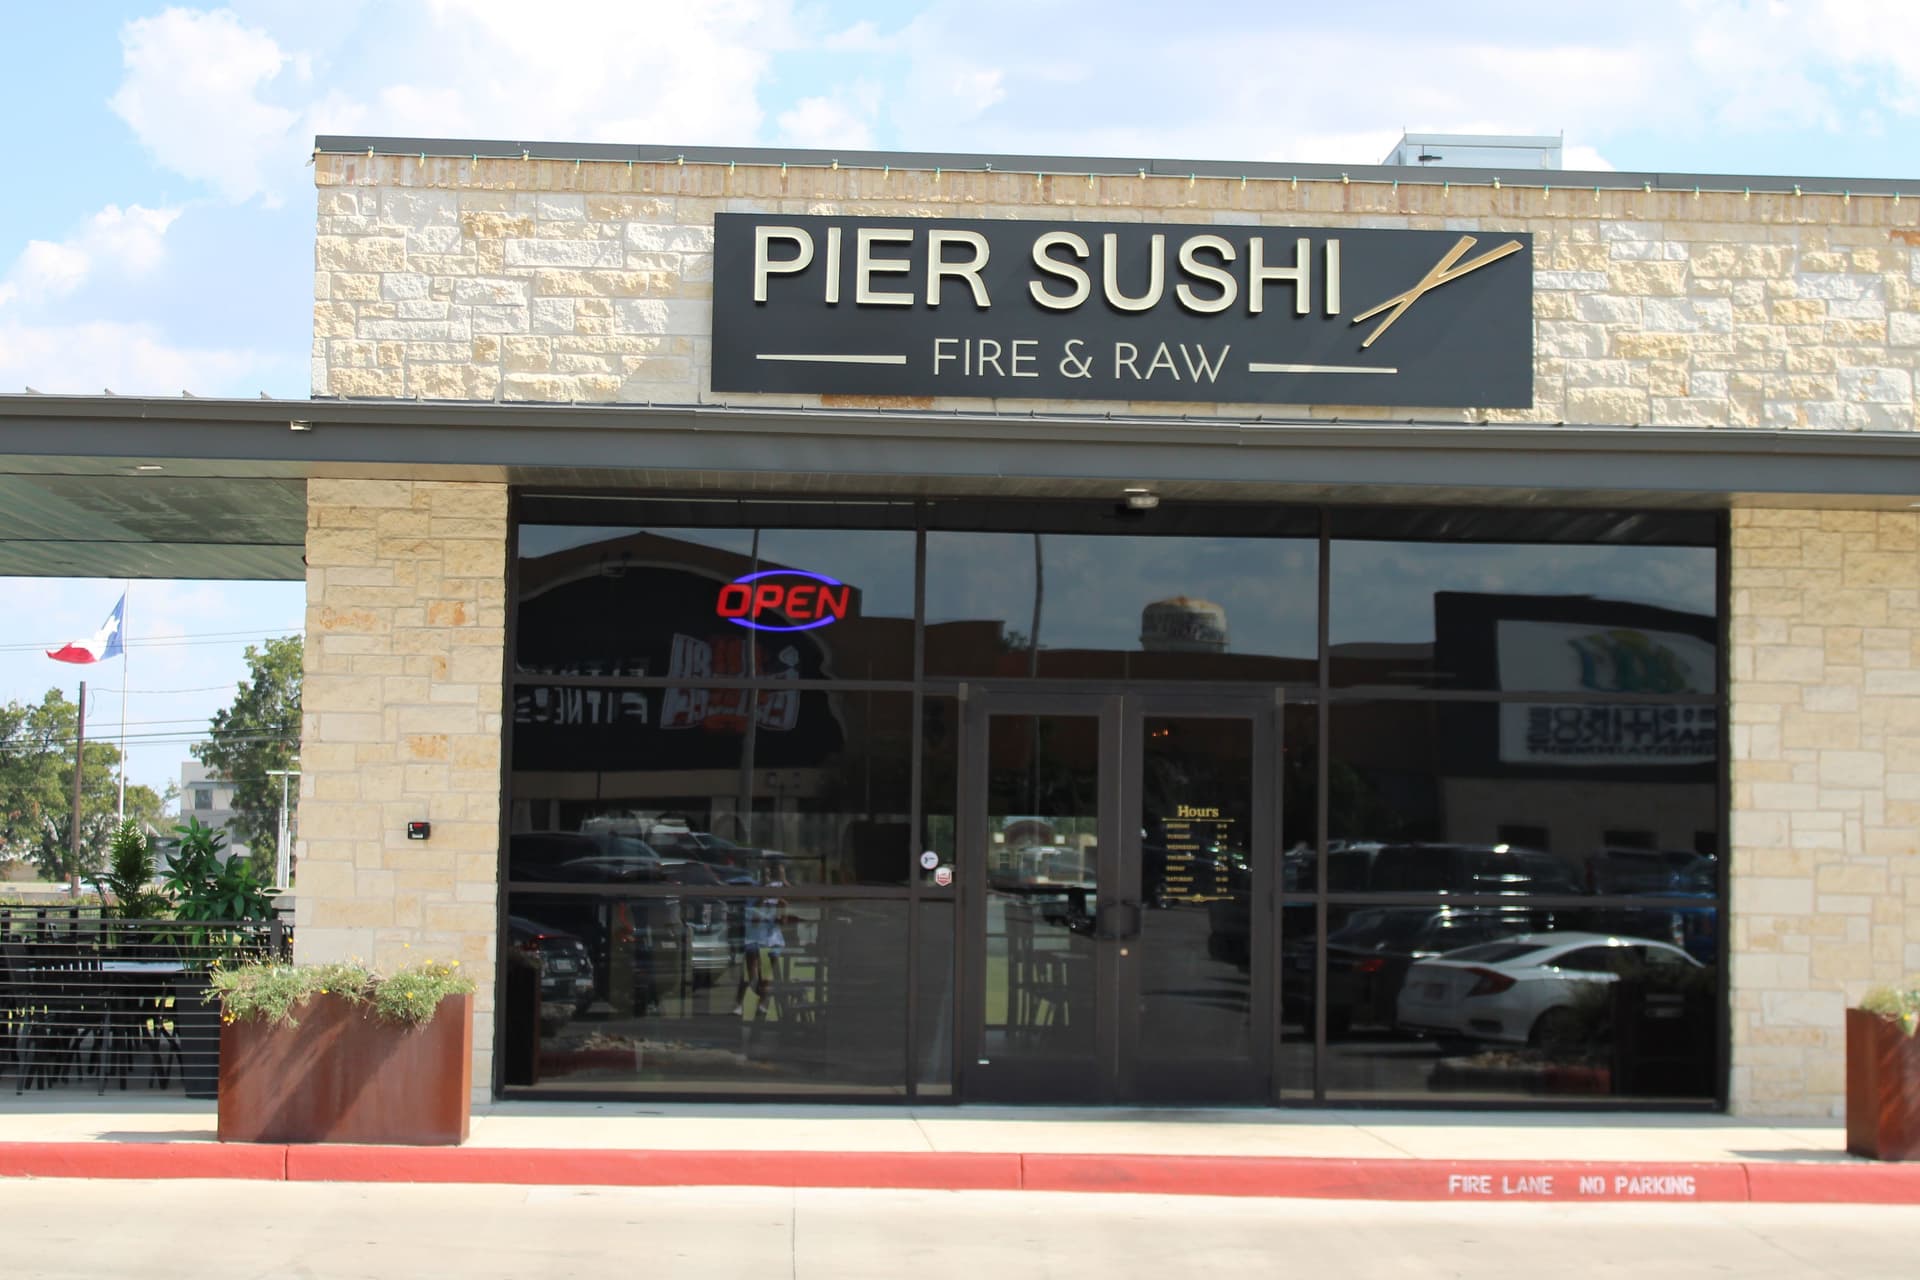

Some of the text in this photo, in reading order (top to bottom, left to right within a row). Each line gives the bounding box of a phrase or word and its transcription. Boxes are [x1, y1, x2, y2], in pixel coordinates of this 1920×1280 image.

[754, 225, 1340, 314] PIER SUSHI
[934, 338, 1230, 383] FIRE & RAW
[716, 584, 849, 619] OPEN
[1177, 805, 1219, 817] Hours
[1449, 1175, 1696, 1195] FIRE LANE NO PARKING
